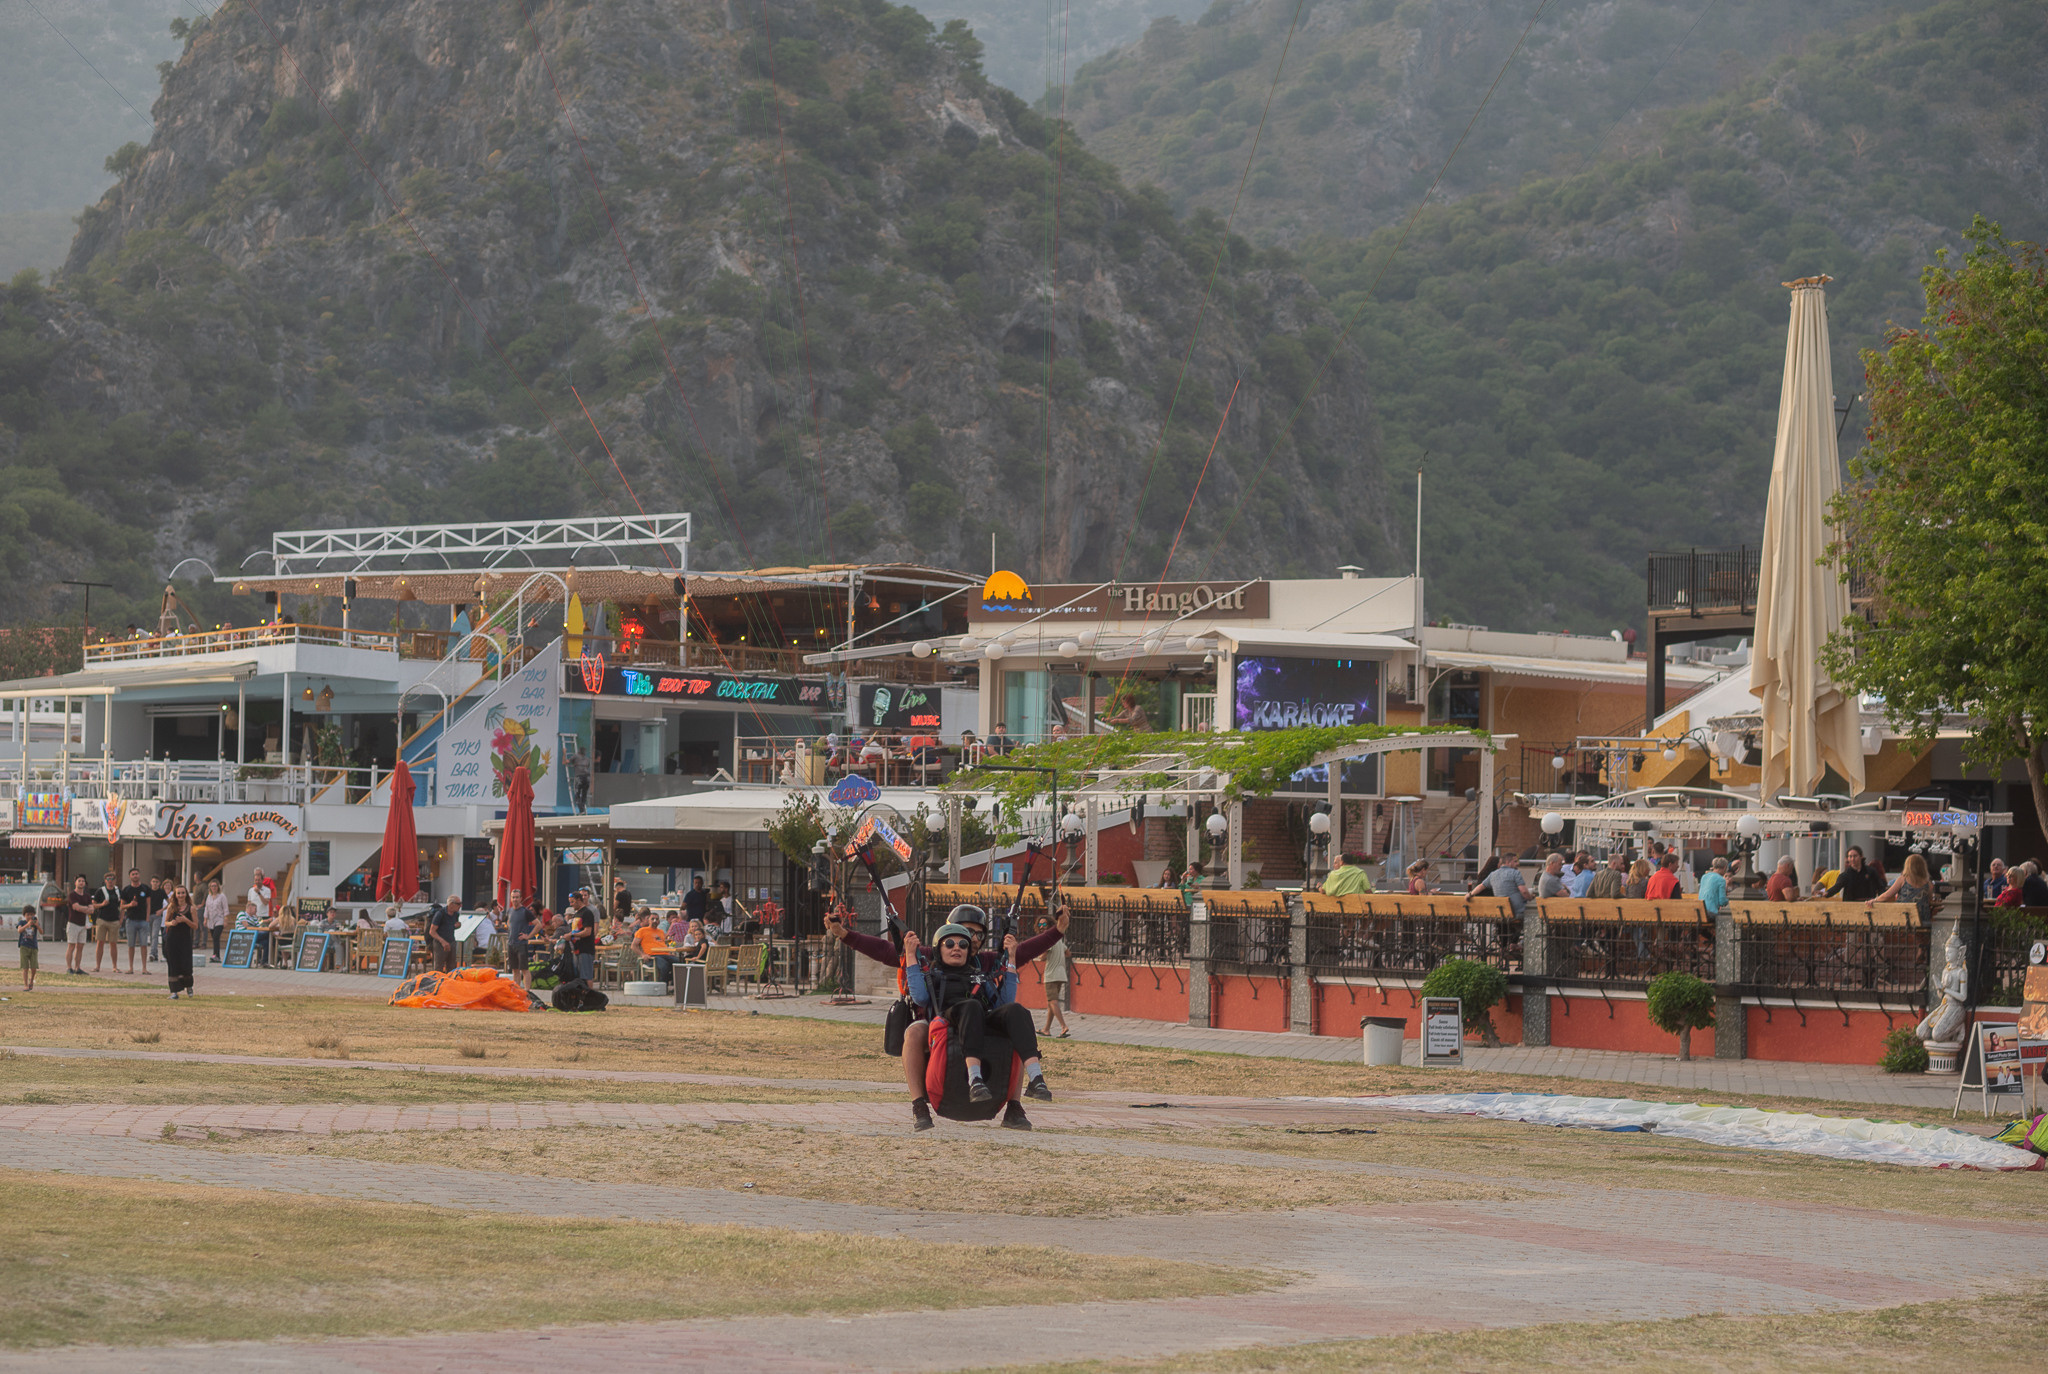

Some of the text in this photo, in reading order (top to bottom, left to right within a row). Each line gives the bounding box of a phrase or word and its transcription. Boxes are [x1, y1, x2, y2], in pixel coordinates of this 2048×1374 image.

[1107, 585, 1245, 617] the HangOut
[522, 668, 547, 682] TIKI
[621, 670, 821, 701] Tiki ROOF TOP COCKTAIL BAR
[520, 687, 545, 700] BAR
[898, 687, 928, 712] Live
[516, 704, 545, 717] TIME
[1253, 700, 1355, 728] KARAOKE
[910, 714, 941, 726] MUSIC
[451, 739, 481, 756] TIKI
[450, 762, 479, 777] BAR
[445, 783, 479, 798] TIME
[830, 786, 879, 801] CLOUD 9
[28, 793, 60, 808] BUBBLE
[26, 809, 60, 824] WAFFLE
[153, 803, 214, 840] Tiki
[217, 811, 299, 837] Restaurant
[244, 826, 273, 841] Bar
[874, 818, 895, 846] PLAZA
[893, 839, 911, 859] BAR
[2020, 1044, 2048, 1058] MARKE
